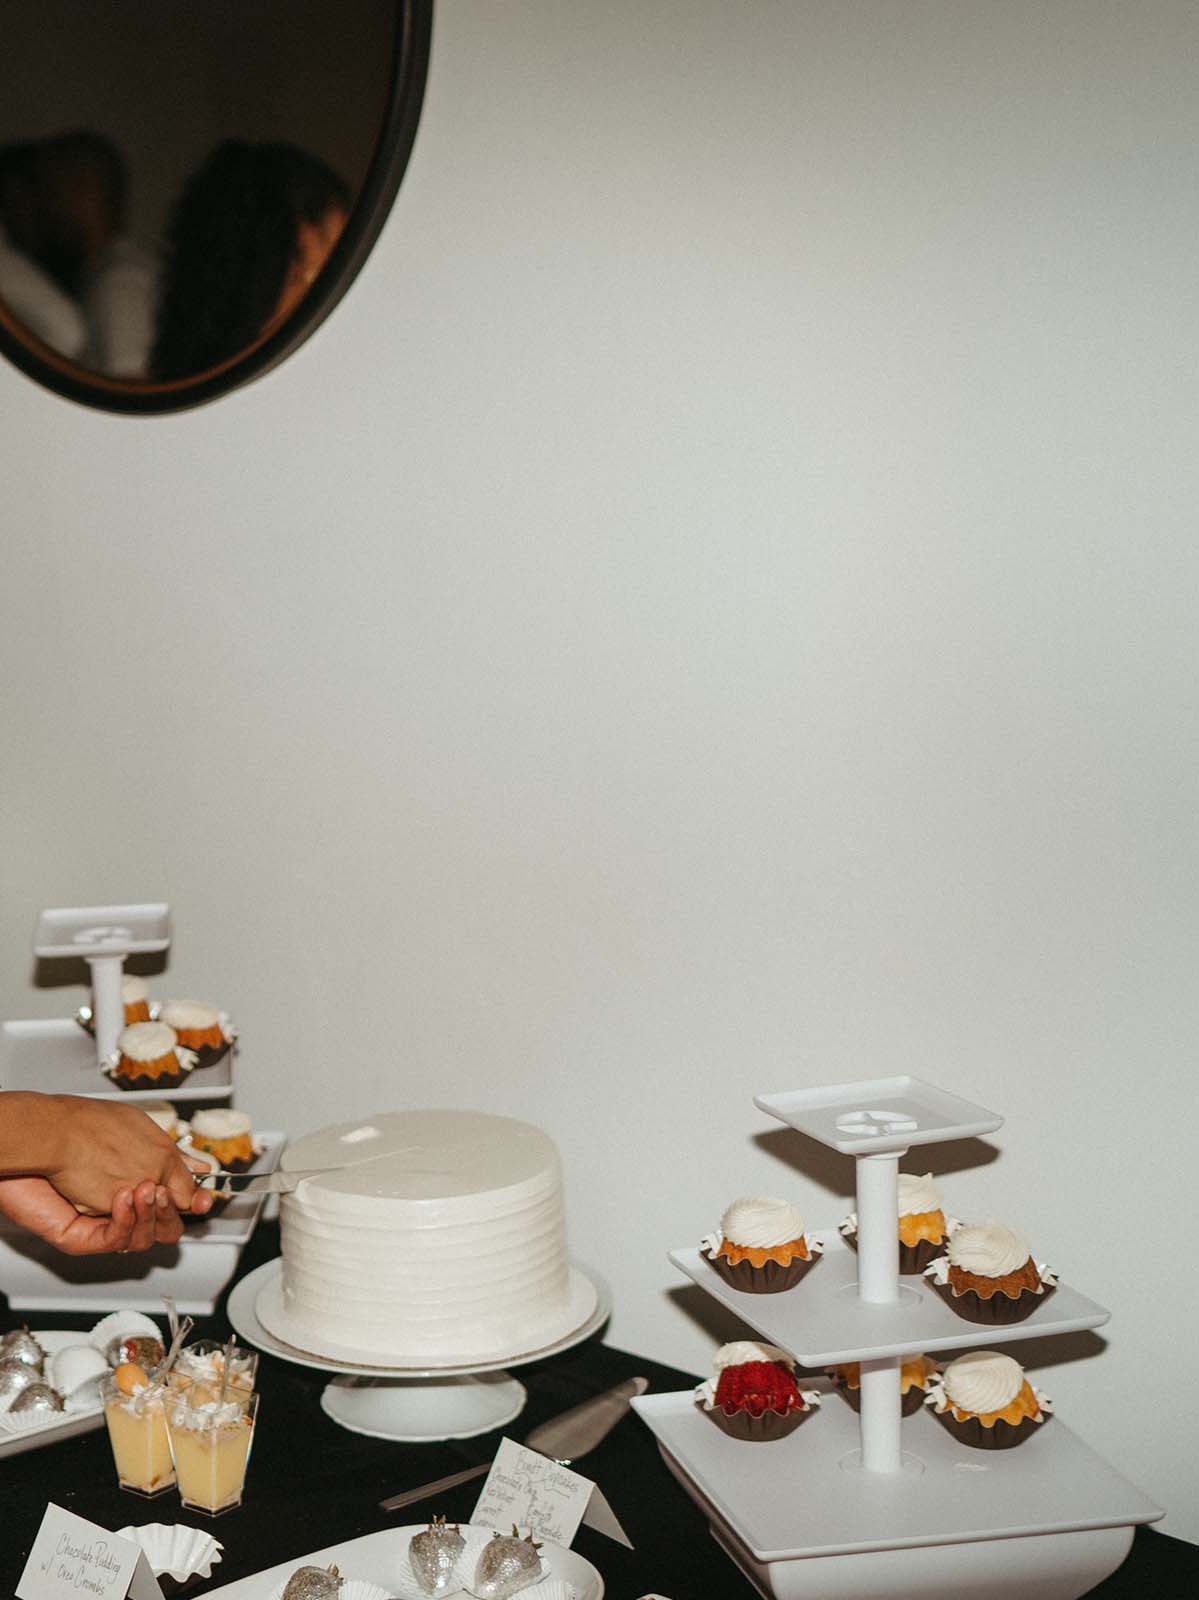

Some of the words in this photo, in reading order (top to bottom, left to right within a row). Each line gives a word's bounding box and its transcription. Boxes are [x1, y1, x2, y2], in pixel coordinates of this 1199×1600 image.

[41, 1556, 55, 1576] w/
[73, 1564, 105, 1596] Crumbs
[55, 1532, 93, 1563] Chocolate
[94, 1540, 121, 1585] Pudding
